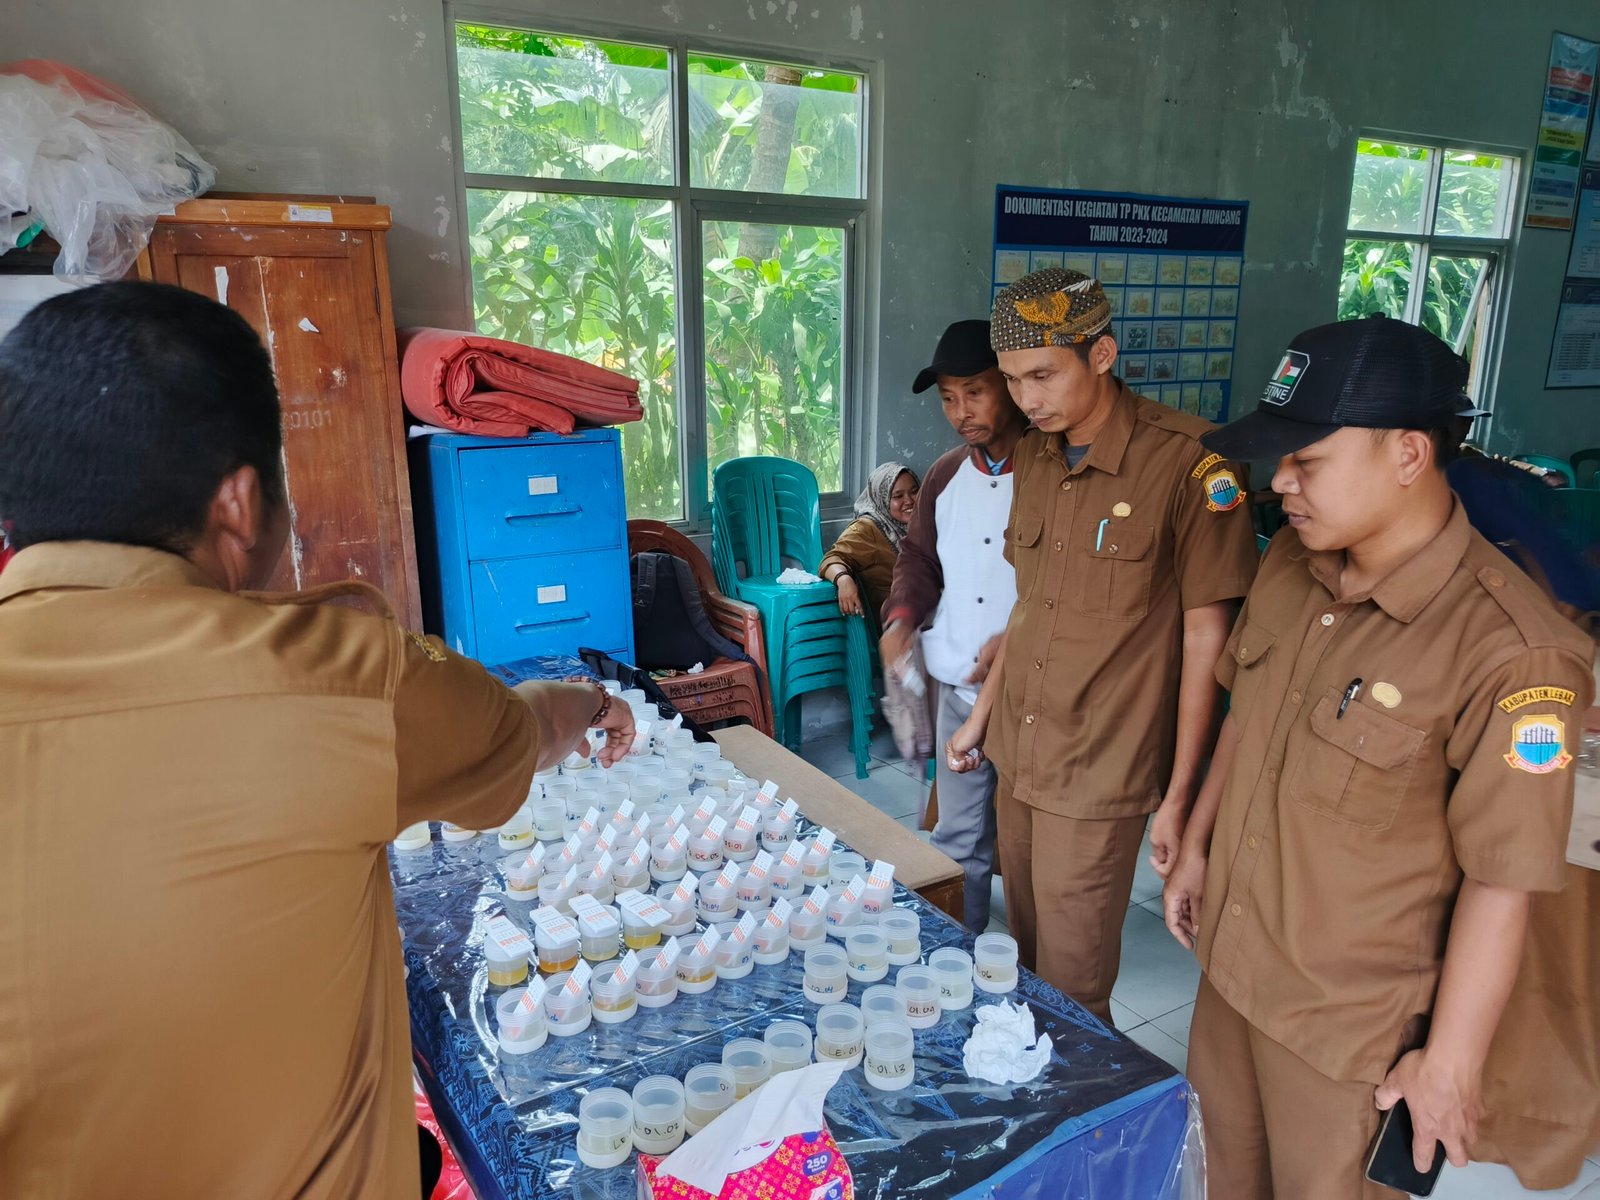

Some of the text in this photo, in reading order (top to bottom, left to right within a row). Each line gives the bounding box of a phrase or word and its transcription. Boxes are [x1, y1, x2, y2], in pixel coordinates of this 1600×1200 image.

[1004, 196, 1073, 217] DOKUMENTASI
[1075, 200, 1118, 219] KEGIATAN
[1120, 203, 1131, 219] TP
[1151, 206, 1201, 224] KECAMATAN
[1201, 209, 1241, 225] MUNCANG
[1089, 225, 1168, 244] TAHUN 2023-2024
[1501, 689, 1574, 710] KABUPATEN LEBAK
[806, 1154, 828, 1169] 250
